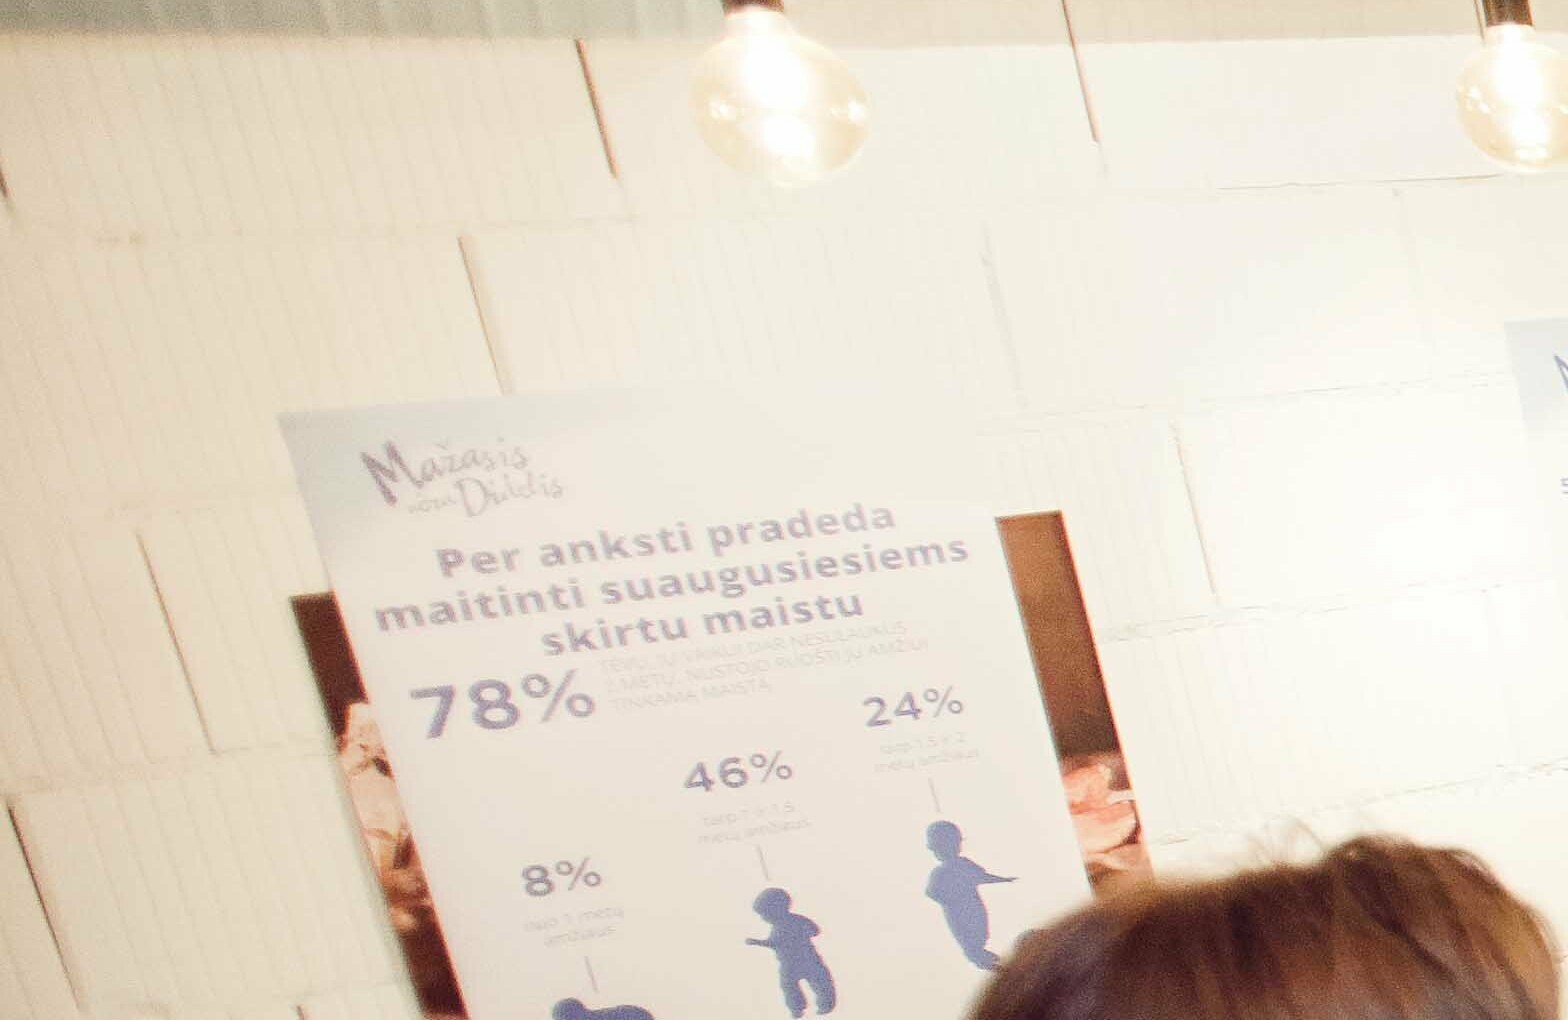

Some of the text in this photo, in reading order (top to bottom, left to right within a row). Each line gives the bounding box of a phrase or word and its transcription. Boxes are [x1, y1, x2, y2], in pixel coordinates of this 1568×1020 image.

[359, 436, 529, 508] Mažasis
[434, 501, 897, 579] Per anksti pradeda
[374, 538, 971, 632] maitinti suaugusiesiems
[540, 594, 865, 657] skirtu maistu
[408, 667, 599, 742] 78%
[861, 684, 966, 731] 24%
[681, 749, 796, 794] 46%
[520, 855, 604, 899] 8%
